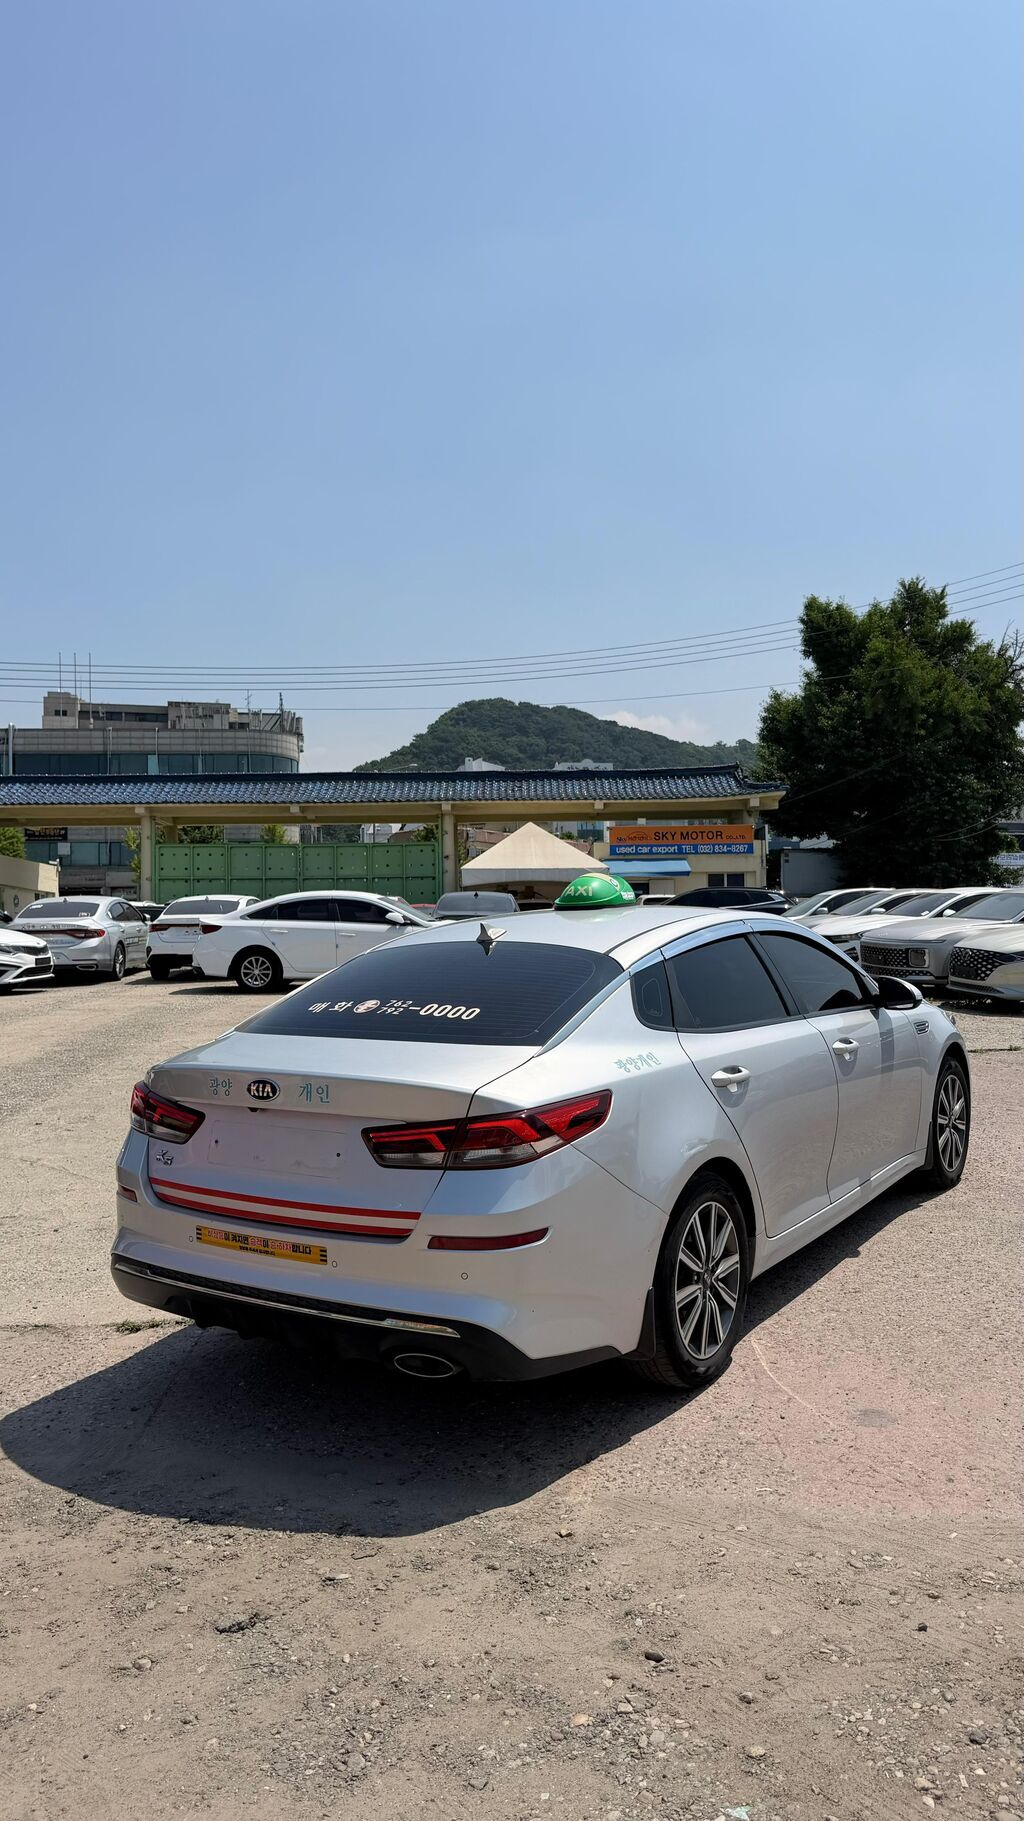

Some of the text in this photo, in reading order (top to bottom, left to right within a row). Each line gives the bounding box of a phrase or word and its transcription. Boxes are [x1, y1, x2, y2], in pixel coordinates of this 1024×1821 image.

[654, 831, 677, 841] SKY
[680, 831, 723, 841] MOTOR
[616, 844, 748, 855] used car export TEL (032) 834-8267
[385, 999, 413, 1008] 762
[376, 1006, 404, 1016] 792
[208, 1078, 331, 1104] 광양 개인
[250, 1082, 274, 1097] KIA
